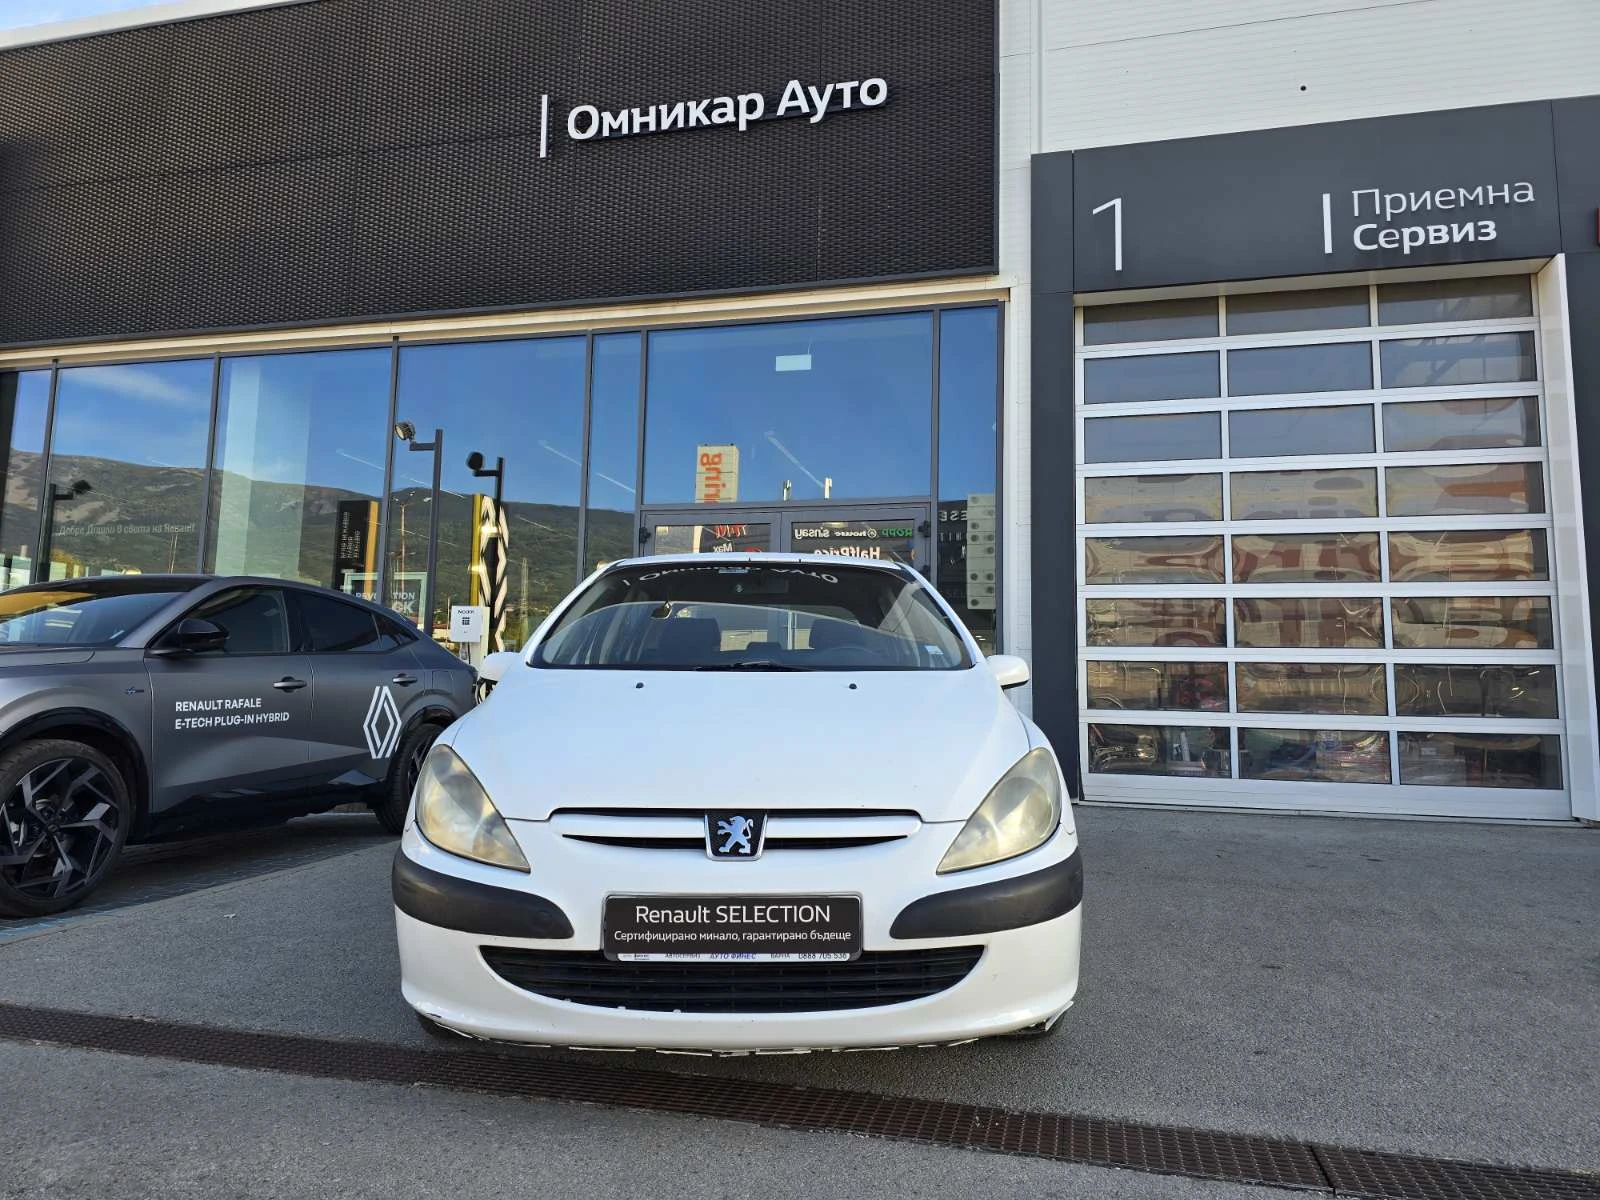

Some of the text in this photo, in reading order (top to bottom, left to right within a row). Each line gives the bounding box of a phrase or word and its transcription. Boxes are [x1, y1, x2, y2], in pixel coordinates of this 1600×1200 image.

[567, 77, 888, 139] Омникар Ауто
[1351, 181, 1536, 221] Приемна
[1092, 197, 1122, 272] 1
[1353, 219, 1498, 254] Сервиз
[175, 698, 262, 712] RENAULT RAFALE
[175, 712, 290, 730] E-TECH PLUG-IN HYBRID
[635, 905, 831, 923] Renault SELECTION
[614, 930, 852, 943] Сертифицирано минало, гарантирано бъдеще
